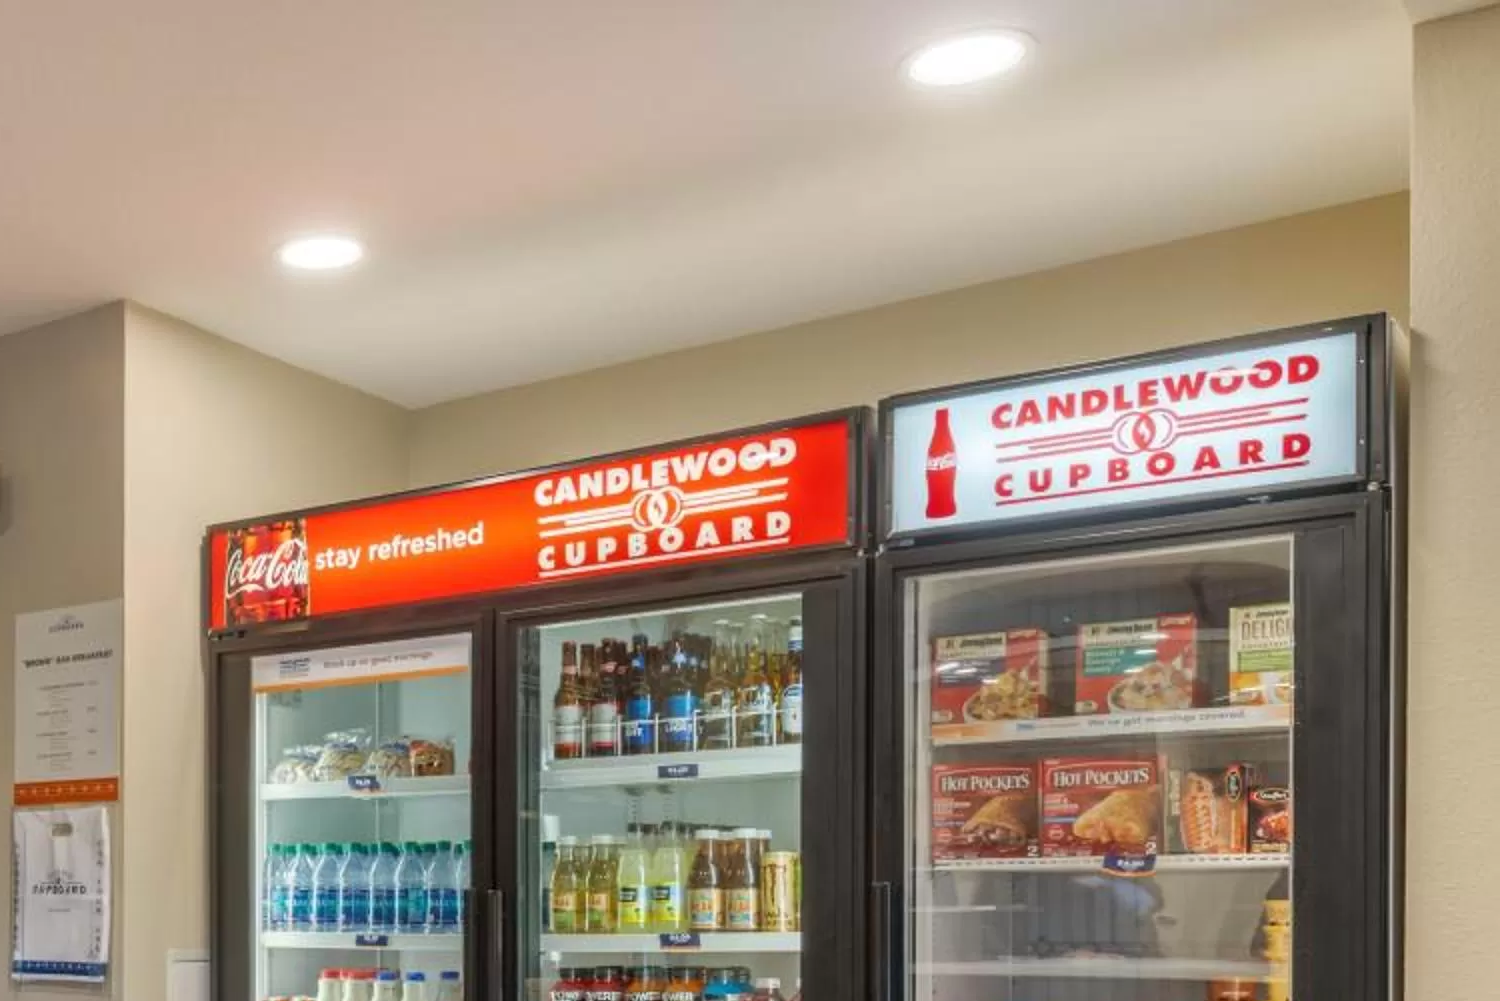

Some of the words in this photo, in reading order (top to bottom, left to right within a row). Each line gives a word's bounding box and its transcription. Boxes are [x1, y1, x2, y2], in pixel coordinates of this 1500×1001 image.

[992, 353, 1321, 430] CANDLEWOOD
[534, 436, 798, 506] CANDLEWOOD
[994, 432, 1311, 498] CUPBOARD
[315, 546, 361, 572] stay
[368, 521, 485, 562] refreshed
[537, 510, 792, 571] CUPBOARD
[941, 776, 968, 791] HOT
[971, 773, 1030, 790] POCKETS
[1054, 771, 1082, 788] HOT
[1085, 767, 1150, 786] POCKETS
